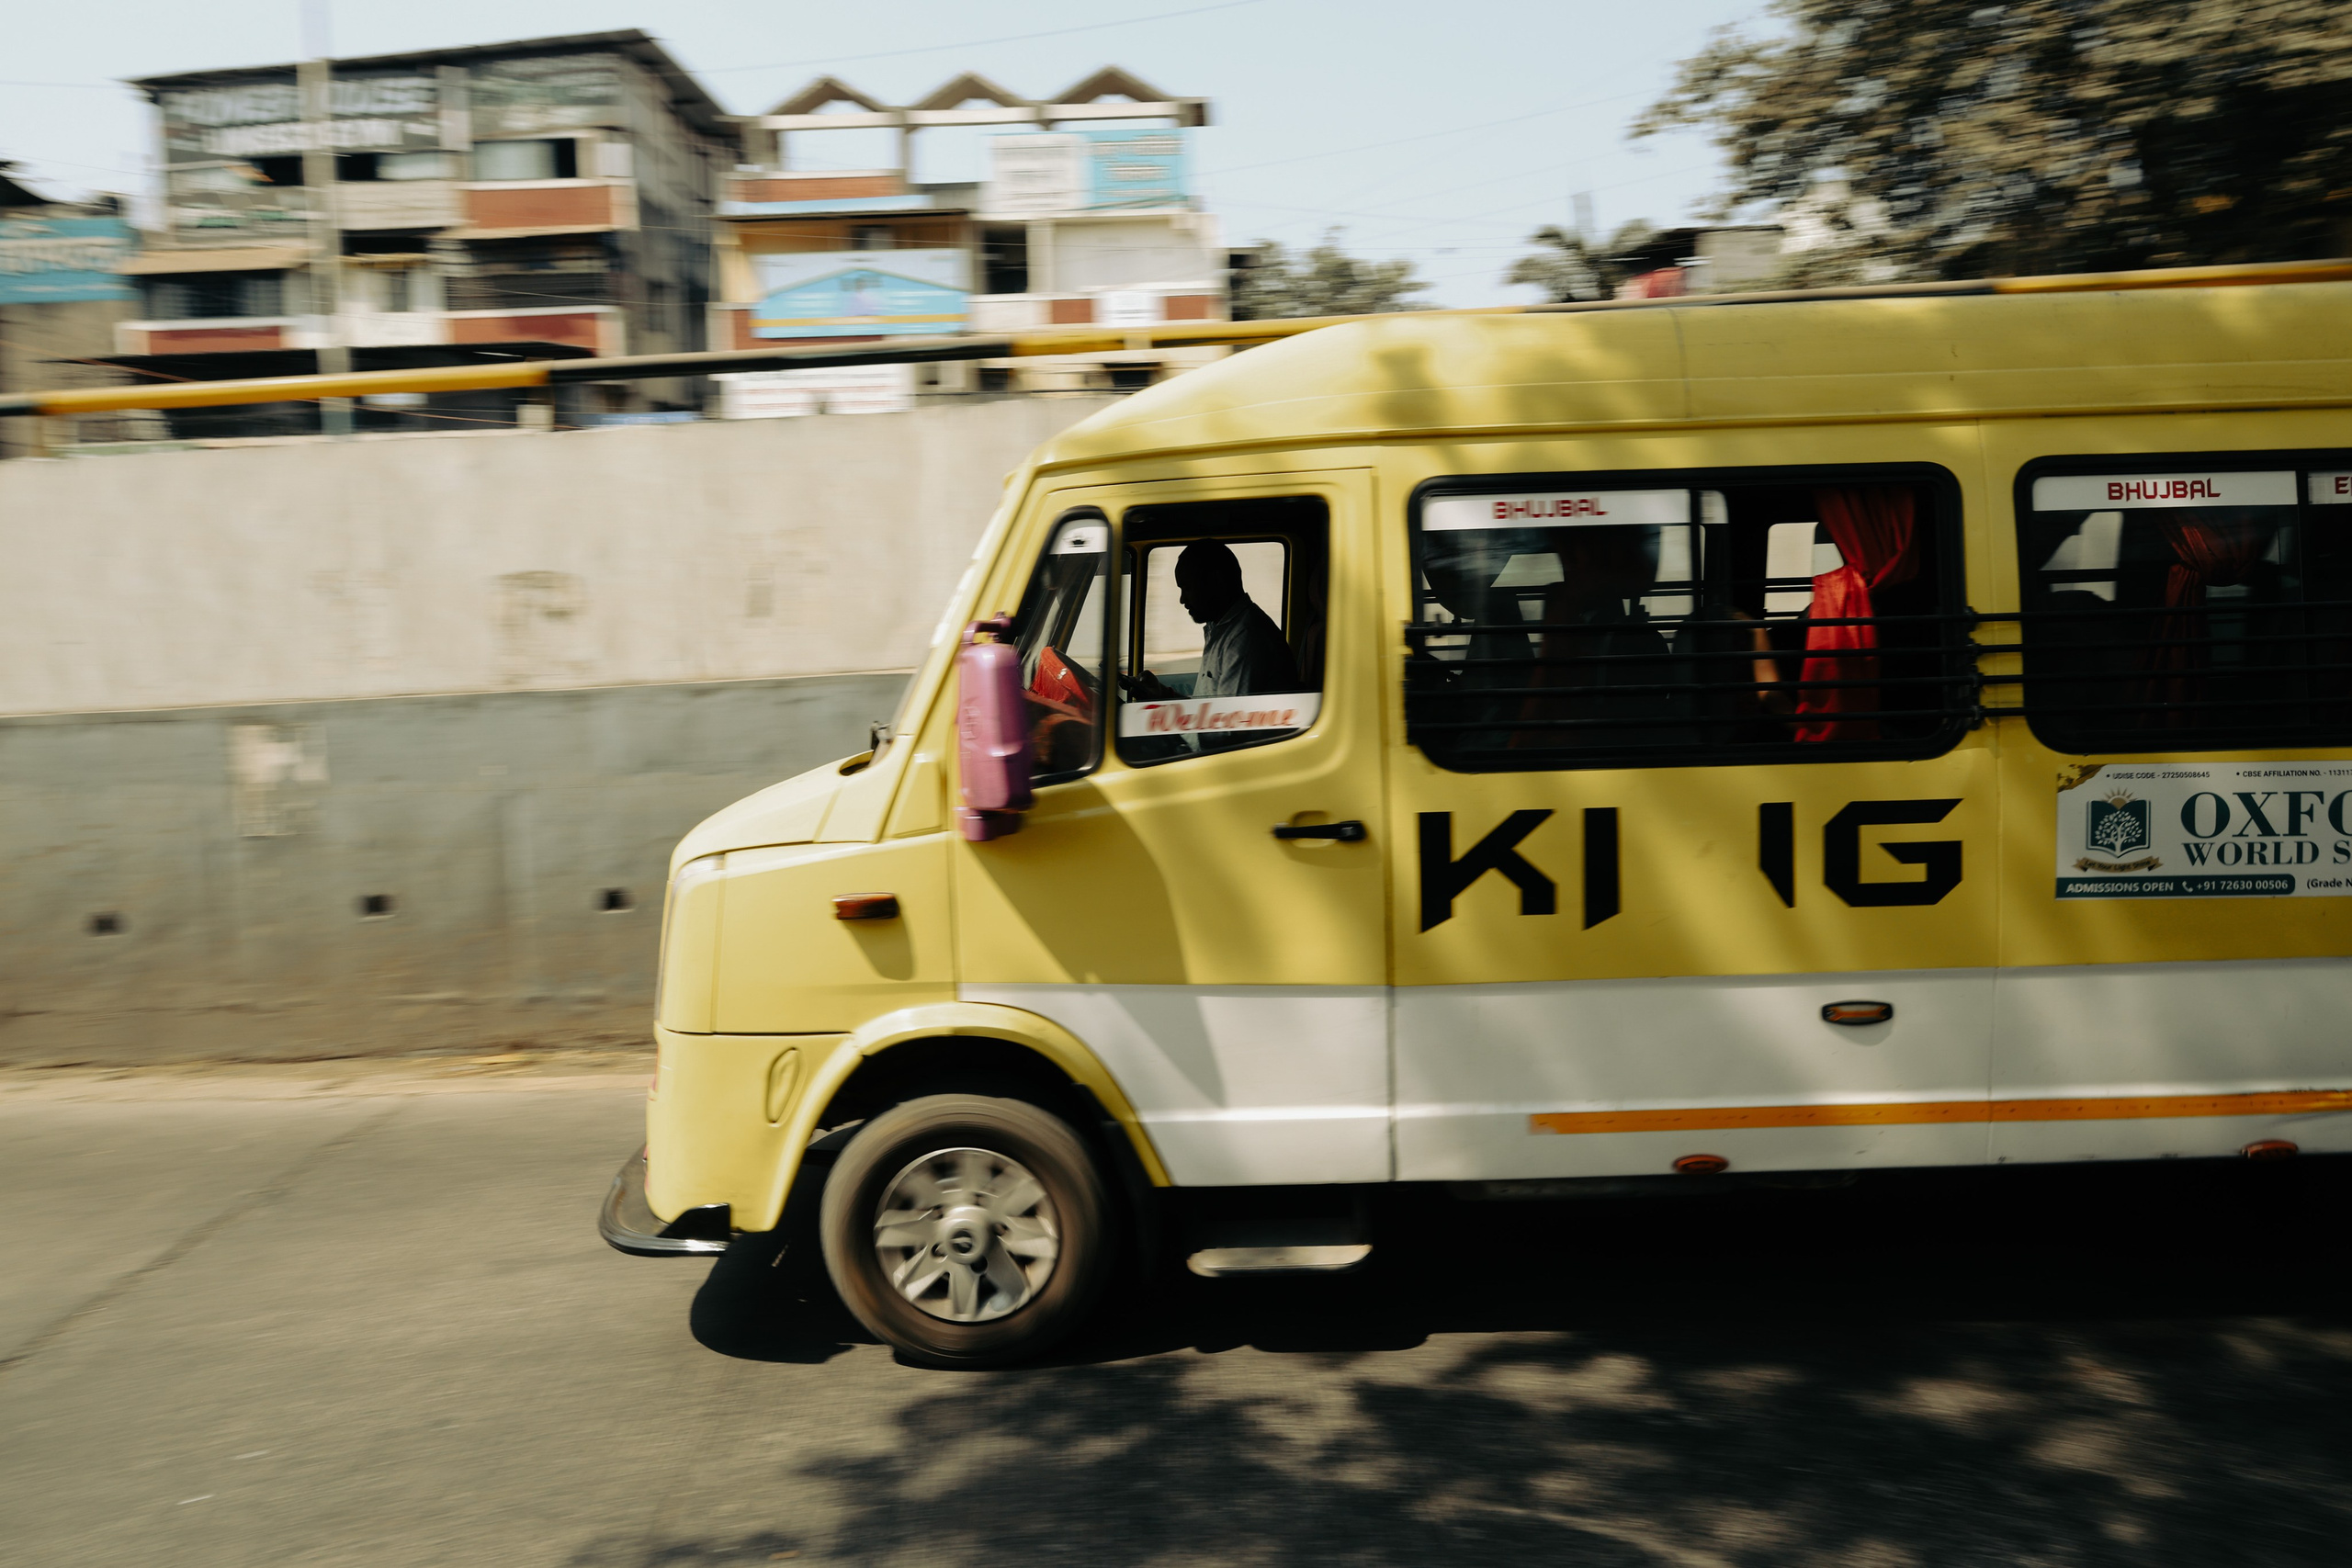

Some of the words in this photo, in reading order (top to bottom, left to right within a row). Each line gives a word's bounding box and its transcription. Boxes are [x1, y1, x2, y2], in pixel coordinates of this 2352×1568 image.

[2107, 477, 2222, 502] BHUJBAL
[2335, 476, 2352, 497] E
[1493, 497, 1609, 520] BHUJBAL
[1136, 702, 1301, 732] Welcome
[2162, 771, 2211, 779] 27250508645
[2181, 840, 2320, 866] WORLD
[2065, 882, 2140, 894] ADMISSIONS
[2142, 881, 2174, 892] OPEN
[2197, 880, 2216, 890] +91
[2220, 880, 2253, 890] 72630
[2255, 879, 2289, 890] 00506
[2306, 877, 2343, 890] (Grade
